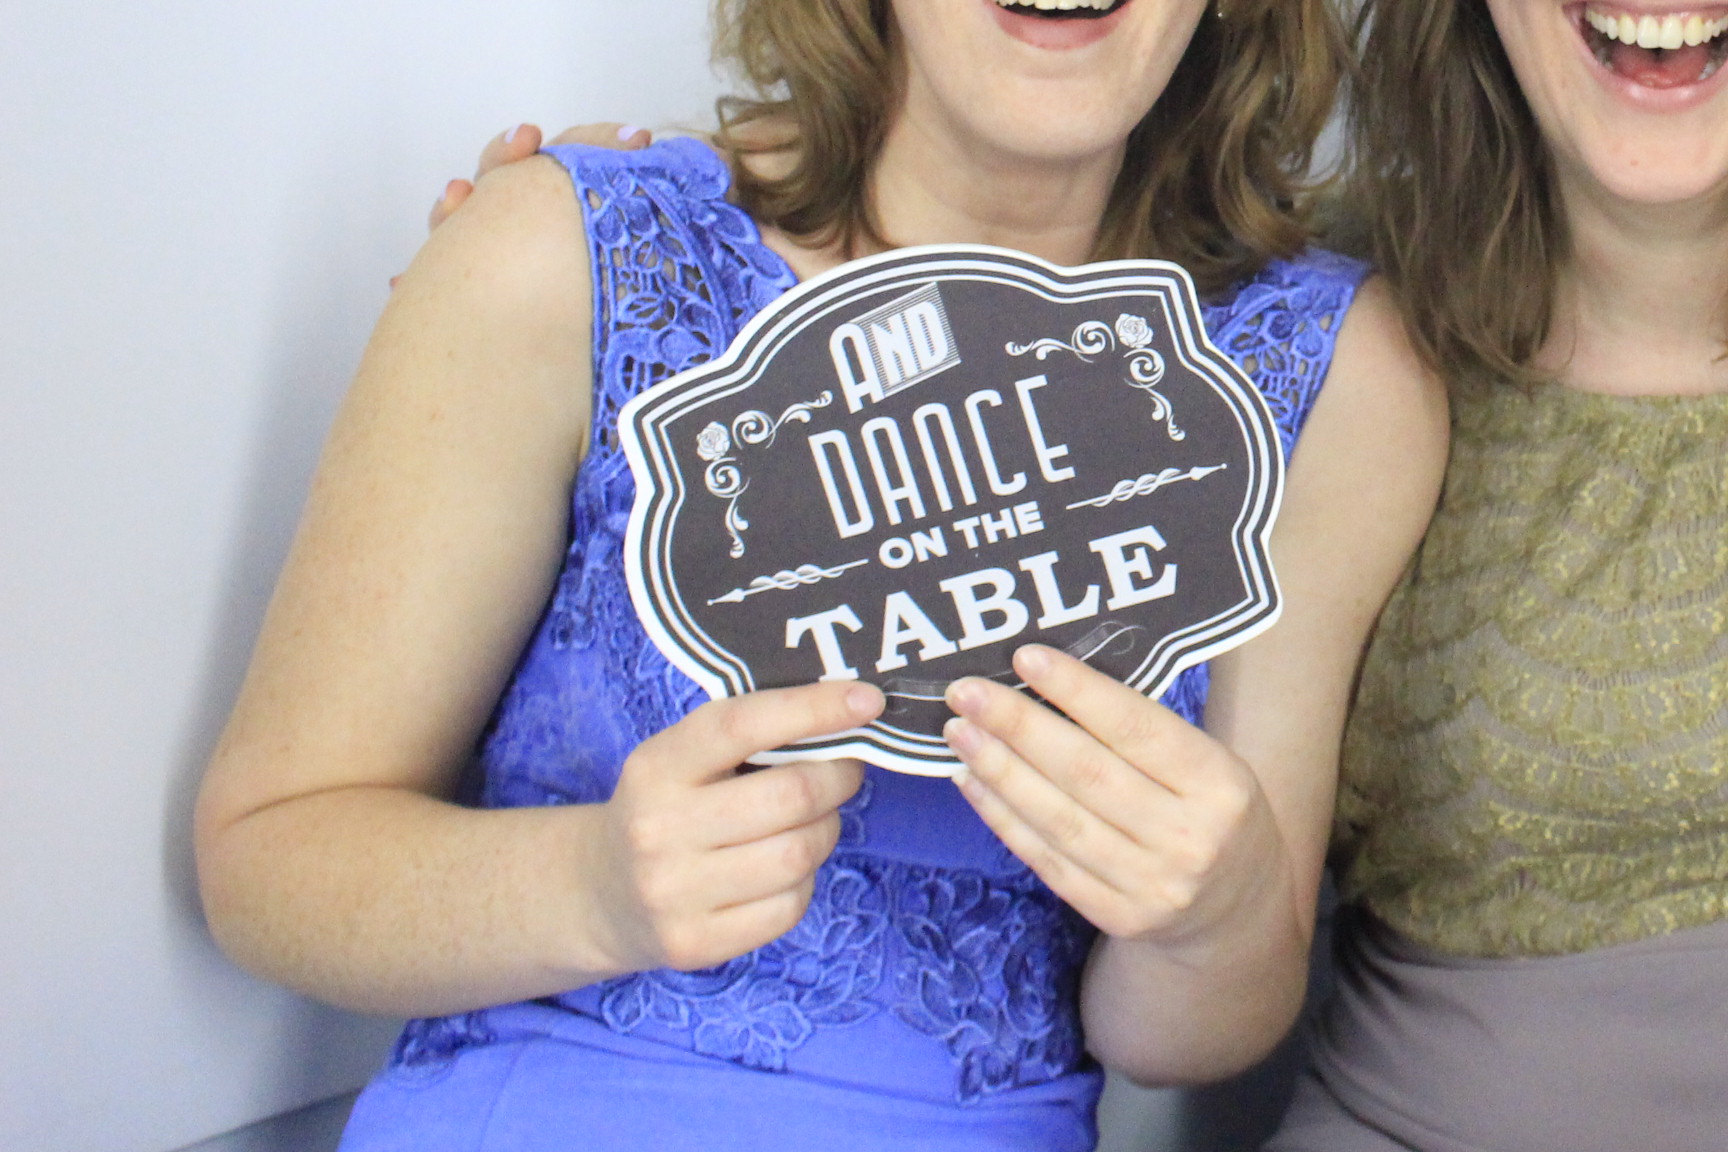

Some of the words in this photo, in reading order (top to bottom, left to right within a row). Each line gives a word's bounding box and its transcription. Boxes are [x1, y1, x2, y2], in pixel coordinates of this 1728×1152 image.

[829, 298, 953, 414] AND
[808, 375, 1076, 539] DANCE
[784, 524, 1178, 683] TABLE
[878, 528, 948, 570] ON
[953, 501, 1045, 550] THE
